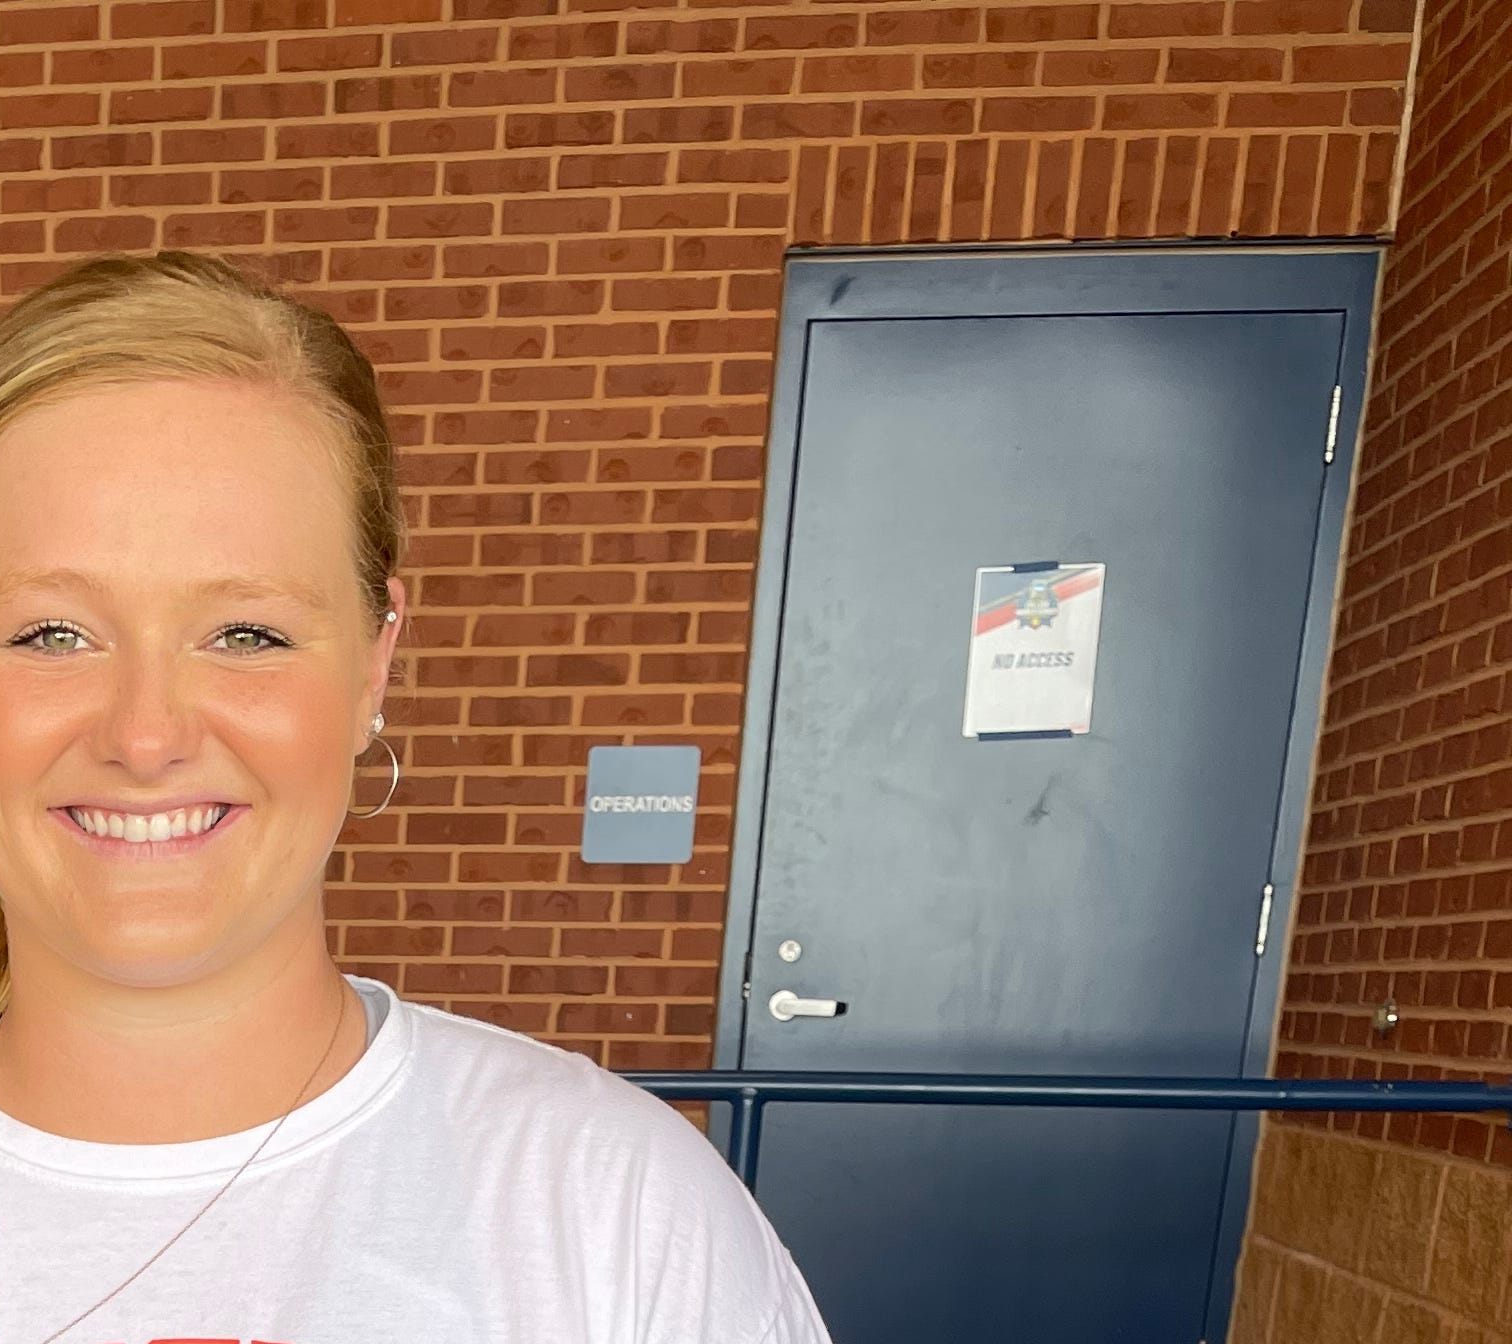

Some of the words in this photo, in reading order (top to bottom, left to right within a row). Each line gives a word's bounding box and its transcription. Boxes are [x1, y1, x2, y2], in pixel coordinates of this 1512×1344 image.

[992, 653, 1015, 670] NO
[1016, 651, 1075, 669] ACCESS
[590, 795, 694, 813] OPERATIONS
